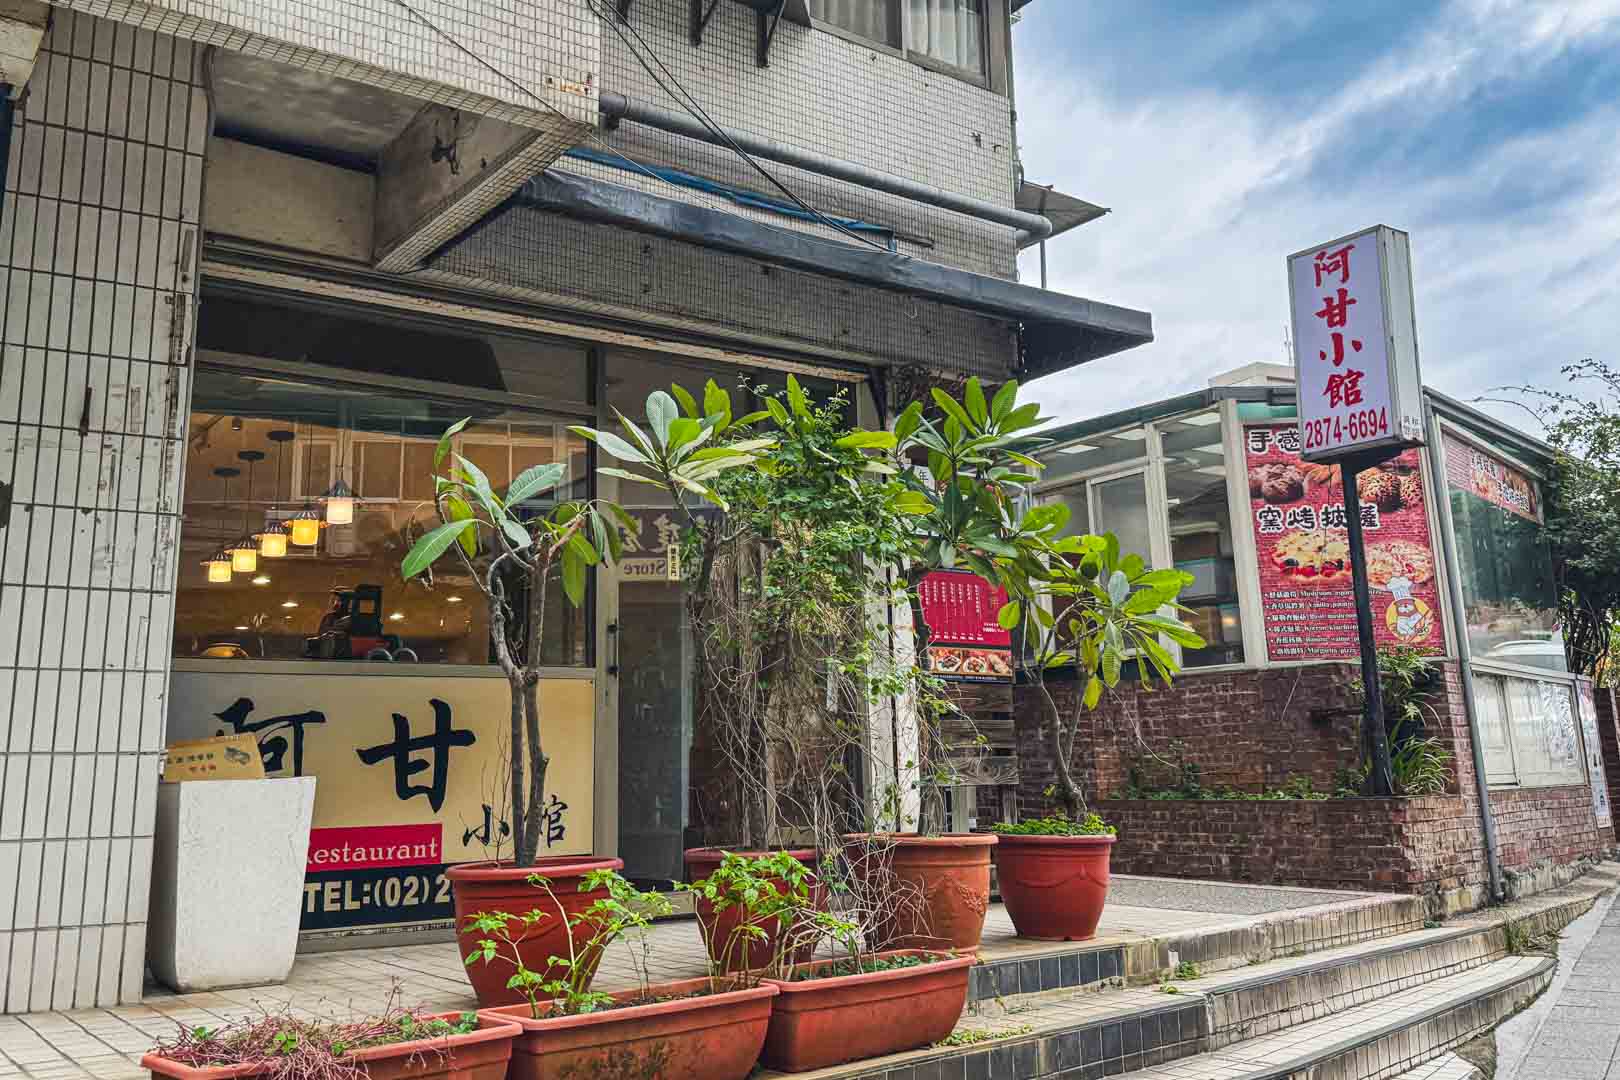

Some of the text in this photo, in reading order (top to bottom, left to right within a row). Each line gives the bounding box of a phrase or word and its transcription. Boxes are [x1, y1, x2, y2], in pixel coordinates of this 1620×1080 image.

[1313, 243, 1364, 408] 阿甘小館
[1305, 407, 1388, 448] 2874-6694
